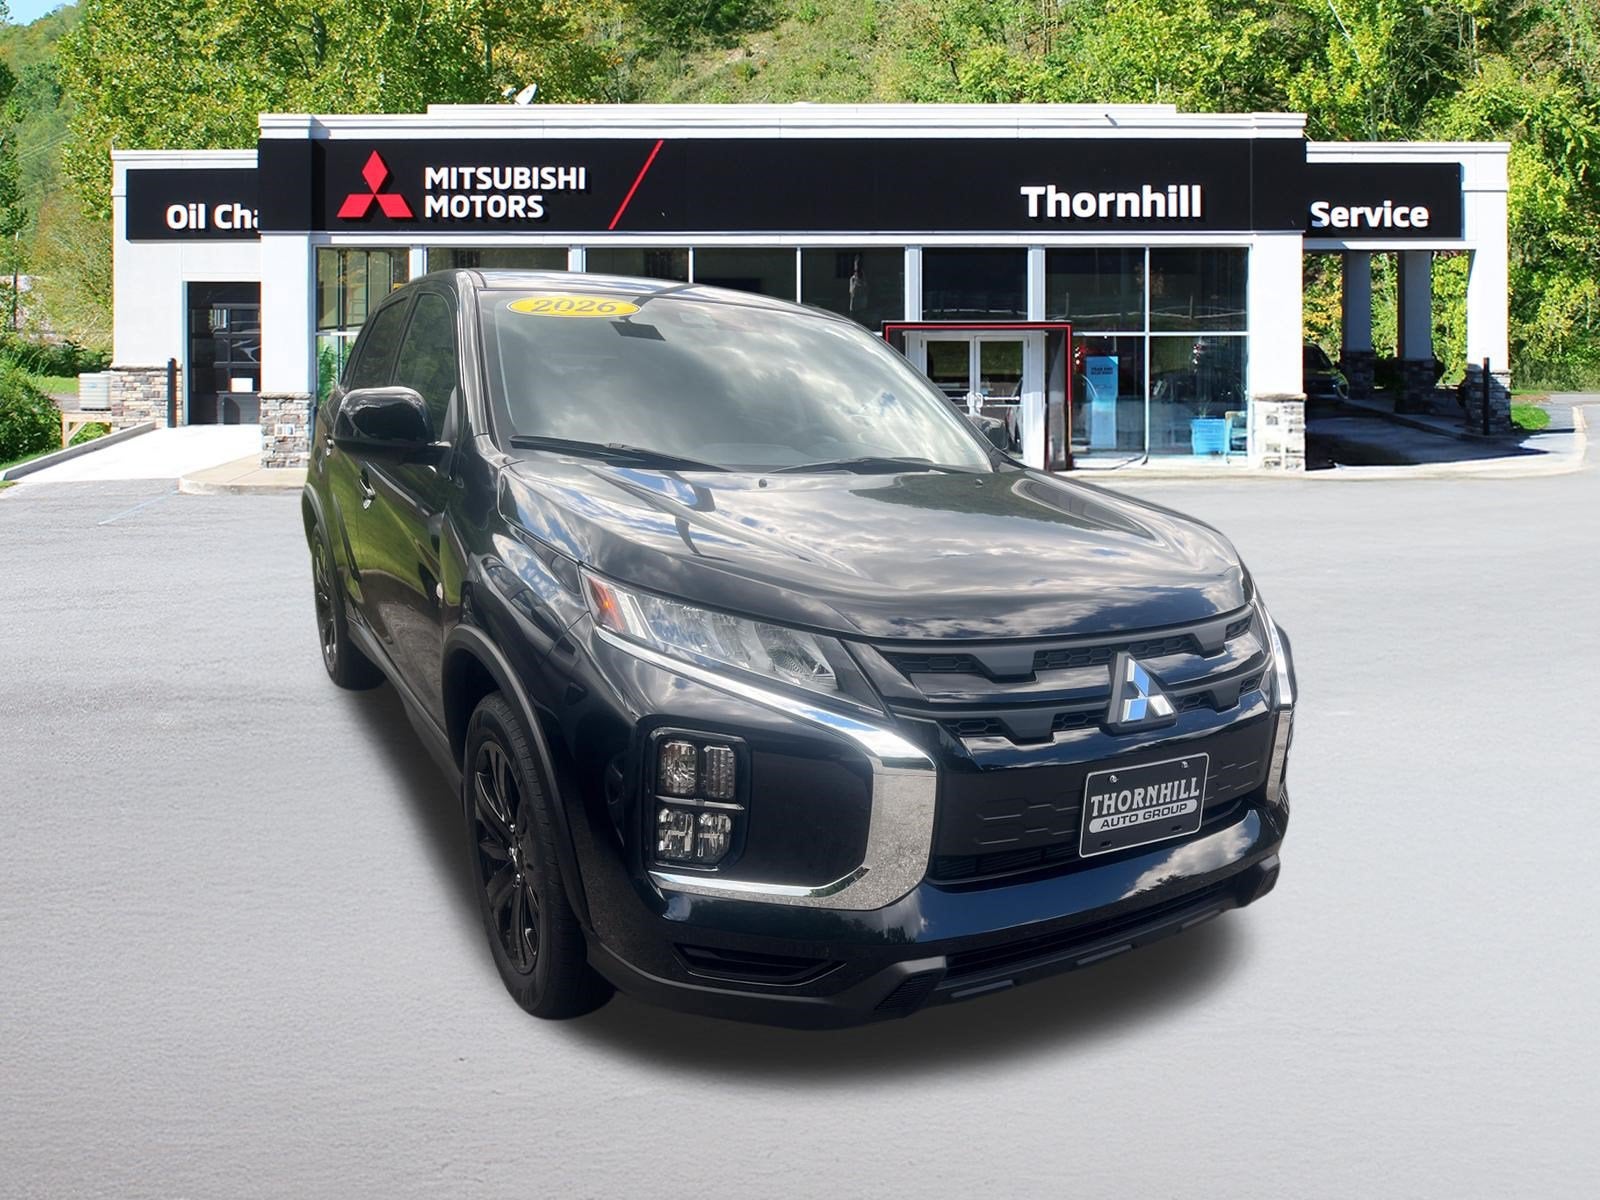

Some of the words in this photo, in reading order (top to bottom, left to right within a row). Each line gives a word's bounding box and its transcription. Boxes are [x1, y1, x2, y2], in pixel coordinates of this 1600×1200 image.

[425, 167, 586, 190] MITSUBISHI
[425, 195, 544, 218] MOTORS
[1020, 184, 1201, 218] Thornhill
[1310, 200, 1429, 228] Service
[166, 203, 206, 229] Oil
[531, 299, 617, 313] 2026
[1090, 777, 1200, 817] THORNHILL
[1100, 813, 1139, 830] AUTO
[1143, 803, 1188, 821] GROUP
